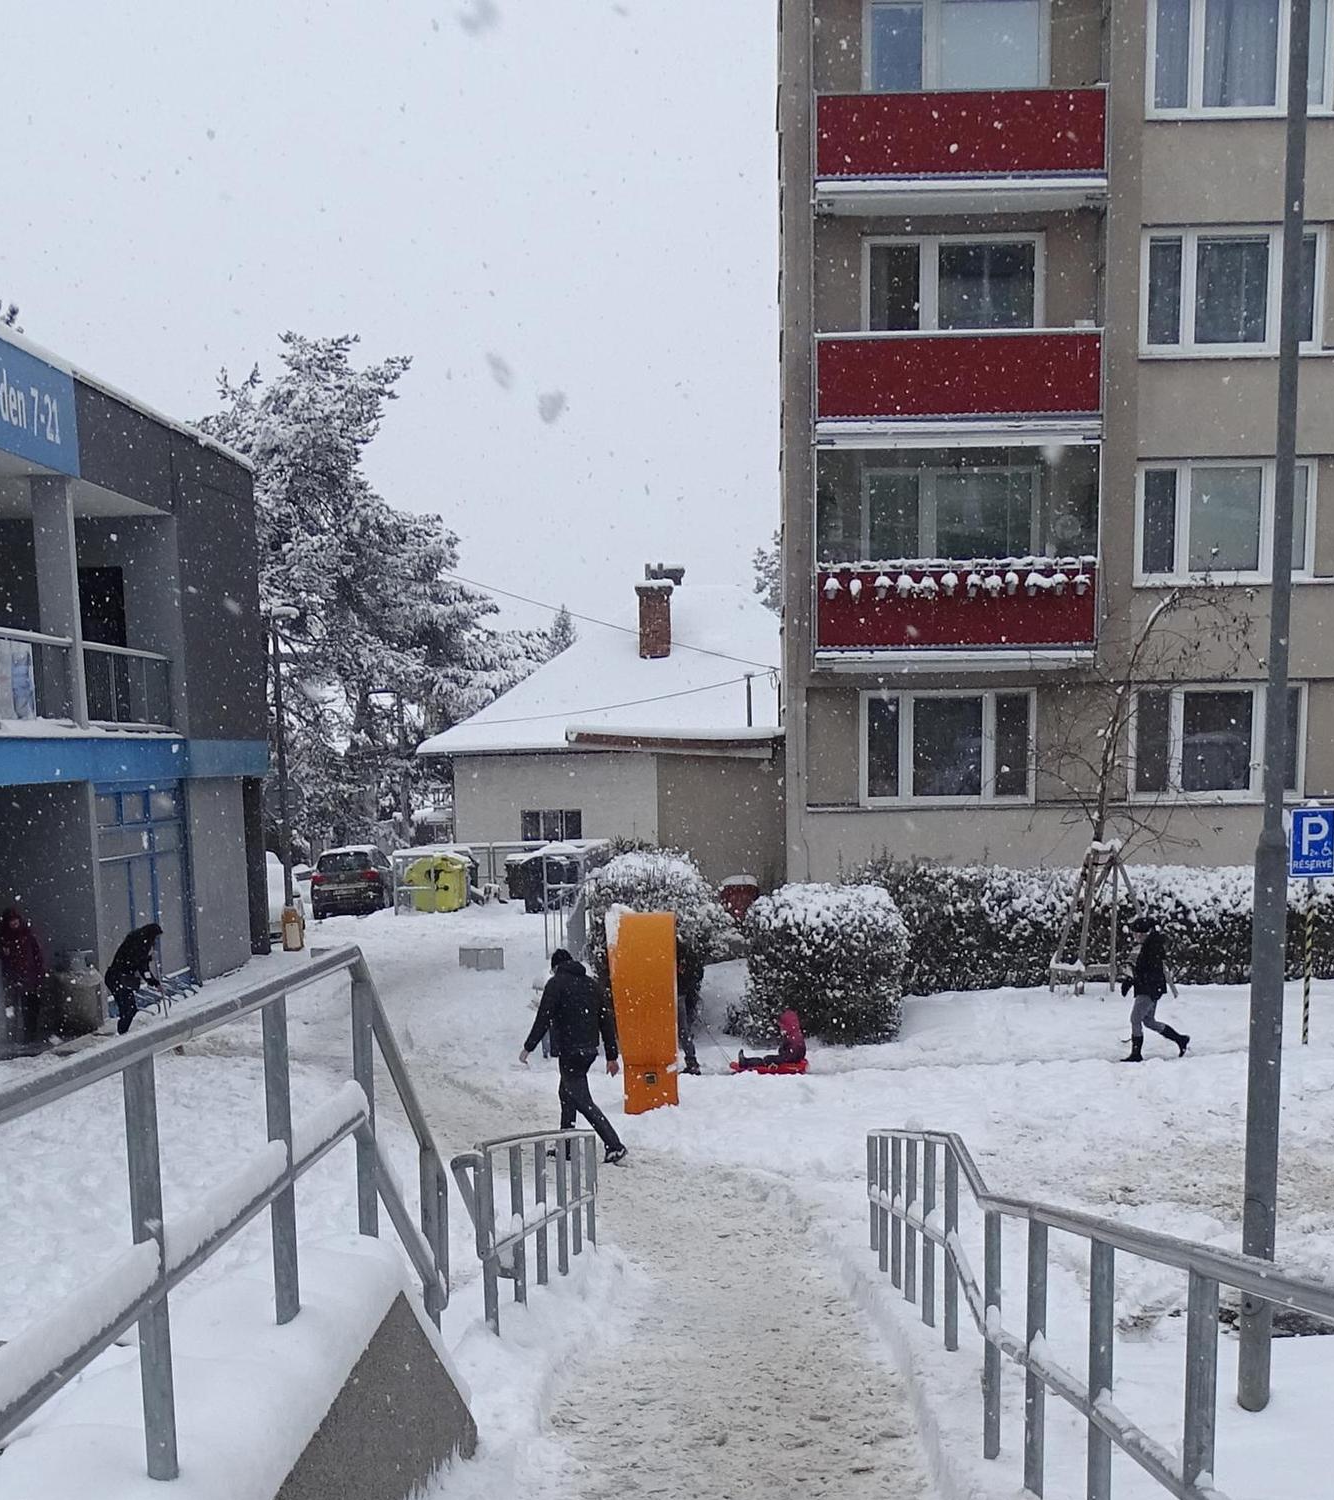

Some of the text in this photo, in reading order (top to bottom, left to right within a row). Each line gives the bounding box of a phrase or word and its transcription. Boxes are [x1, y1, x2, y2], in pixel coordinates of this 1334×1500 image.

[0, 368, 27, 430] den
[30, 386, 61, 445] 7-21
[1302, 816, 1329, 856] P
